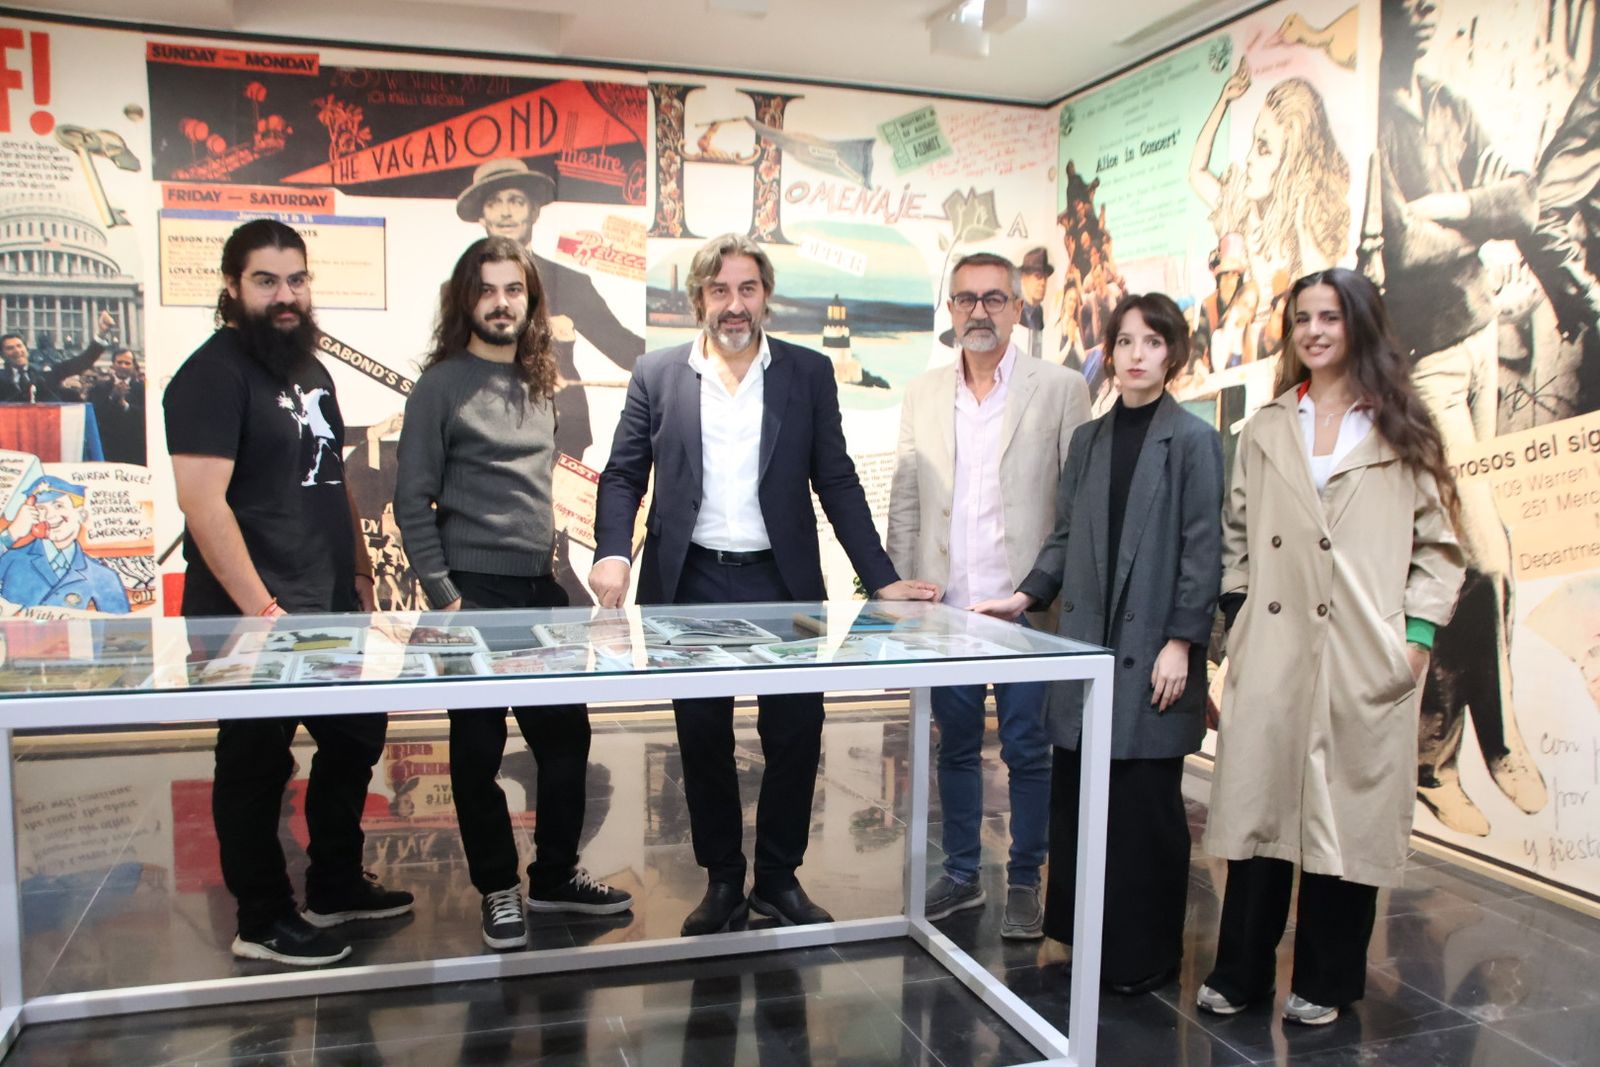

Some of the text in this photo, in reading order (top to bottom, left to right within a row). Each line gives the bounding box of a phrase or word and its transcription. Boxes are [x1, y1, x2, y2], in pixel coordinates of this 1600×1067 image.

[151, 44, 315, 71] SUNDAY MONDAY
[329, 95, 559, 185] THE VAGABOND
[1095, 153, 1119, 173] Alice
[167, 188, 329, 207] FRIDAY SATURDAY
[1524, 433, 1559, 463] del
[72, 469, 153, 485] FAIRFAX POLICE!
[559, 456, 595, 481] LOST
[1527, 466, 1588, 492] Warren
[92, 490, 130, 498] OFFICER
[1521, 498, 1548, 520] 251
[87, 526, 153, 540] EMERGENCY?
